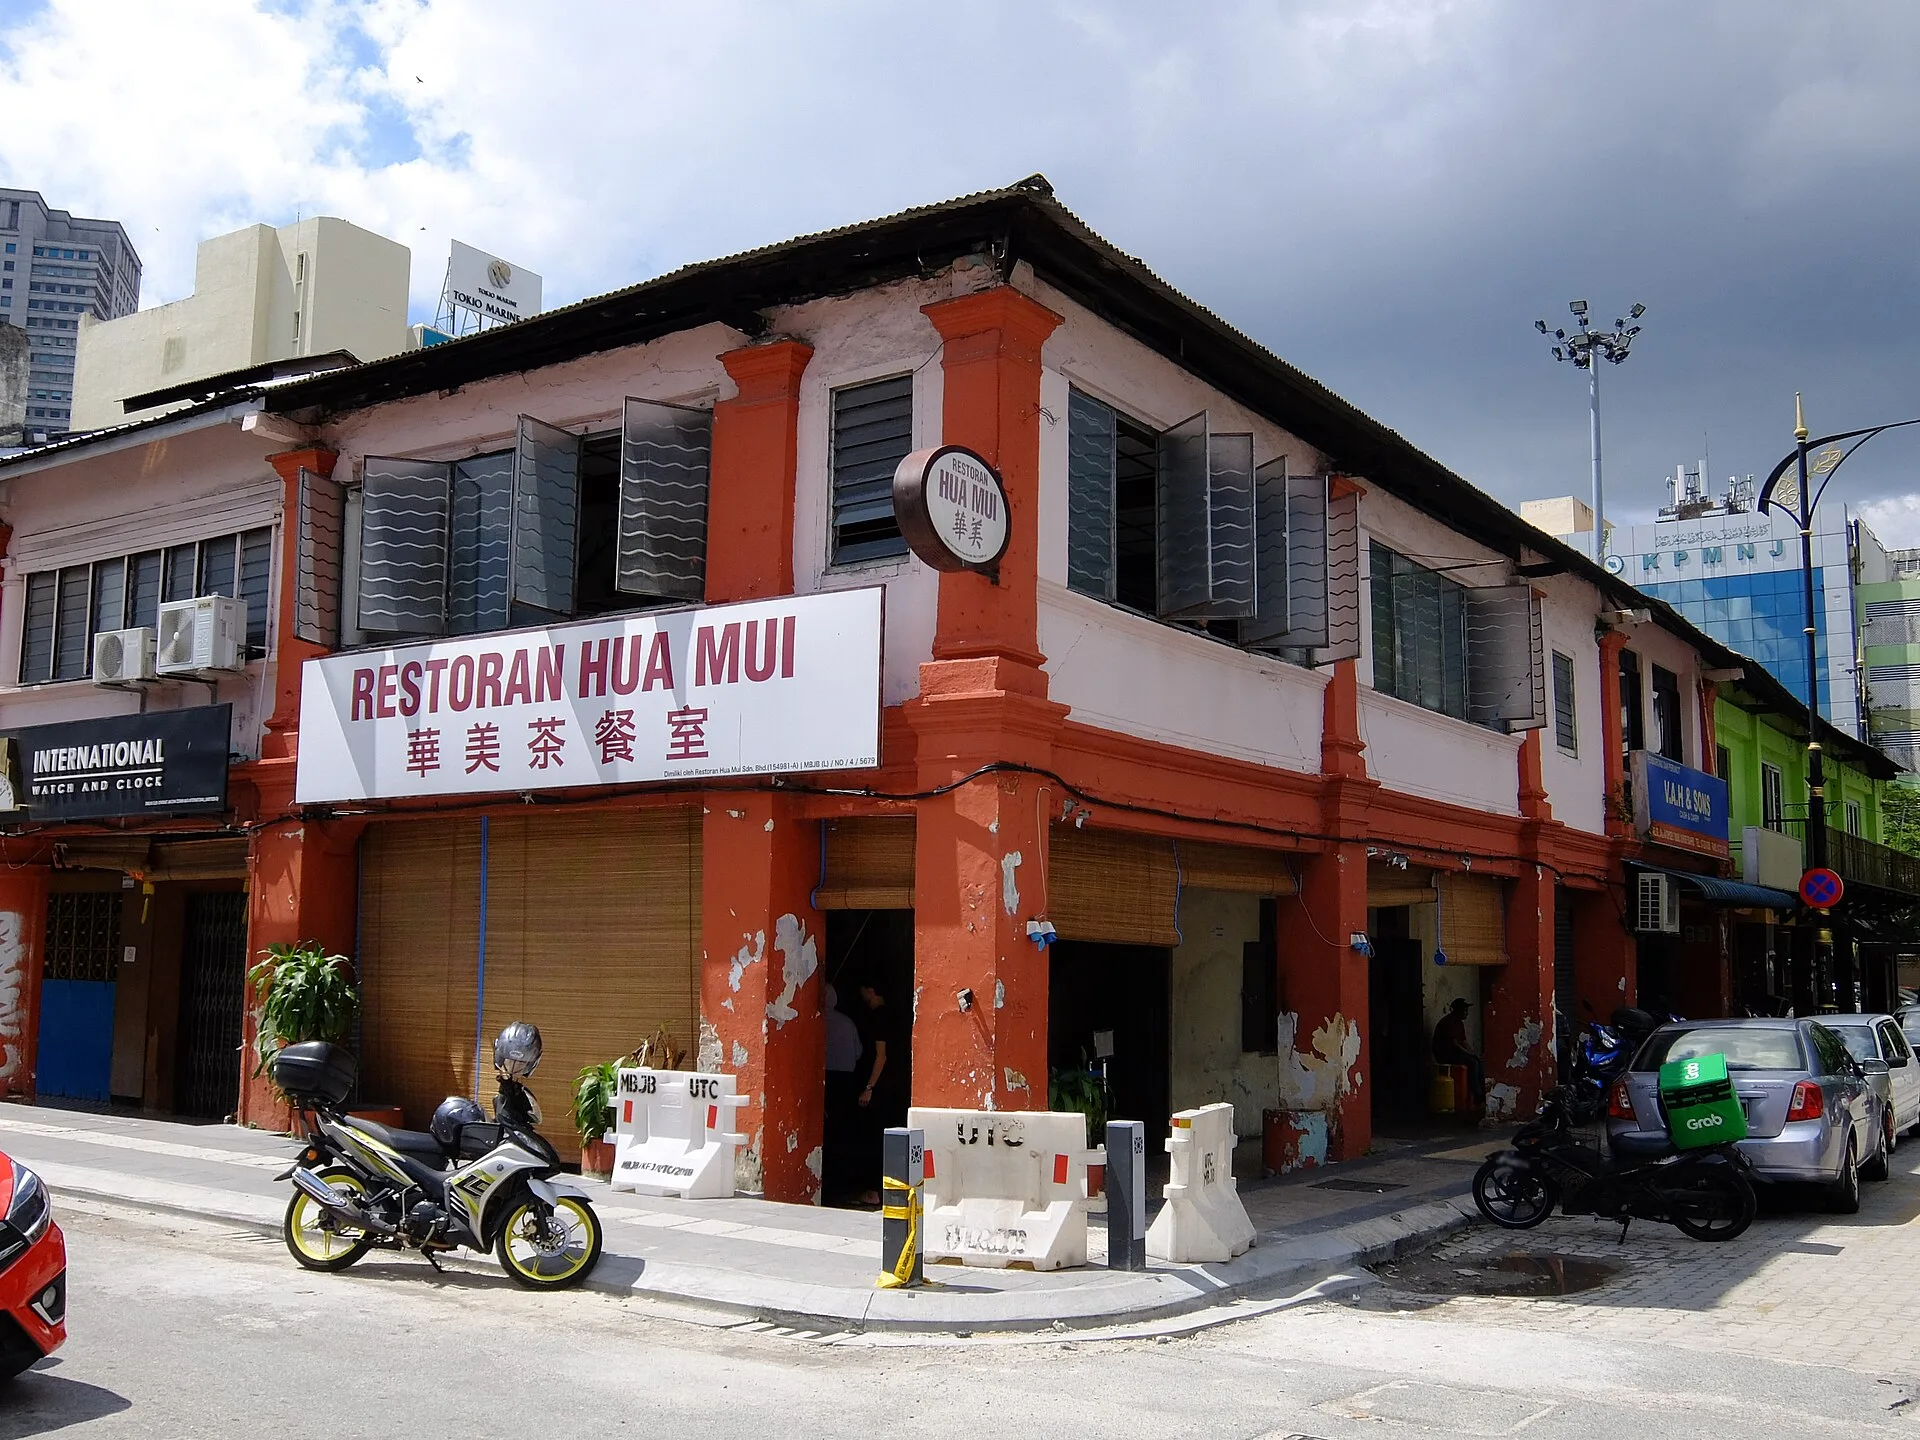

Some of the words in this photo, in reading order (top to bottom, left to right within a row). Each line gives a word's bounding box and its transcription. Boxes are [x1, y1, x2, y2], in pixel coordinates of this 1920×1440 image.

[453, 290, 482, 309] TOKIO
[485, 303, 521, 322] MARINE
[478, 287, 495, 299] TOKIO
[496, 294, 517, 308] MARINE
[952, 458, 989, 486] RESTORAN
[939, 469, 967, 508] HUA
[972, 484, 997, 522] MUI
[952, 509, 983, 550] 華美
[351, 644, 565, 722] RESTORAN
[578, 630, 674, 699] HUA
[695, 615, 797, 689] MUI
[33, 738, 165, 774] INTERNATIONAL
[406, 704, 709, 778] 華美茶餐室
[694, 767, 719, 775] Restoran
[719, 766, 730, 774] Hua
[32, 782, 74, 796] WATCH
[81, 780, 109, 793] AND
[116, 776, 163, 790] CLOCK
[1685, 787, 1692, 810] &
[1693, 789, 1711, 817] SONS
[620, 1073, 657, 1094] MBJB
[689, 1078, 719, 1100] UTC
[1684, 1062, 1699, 1081] Grab
[956, 1116, 1025, 1148] UTC
[1686, 1113, 1723, 1131] Grab
